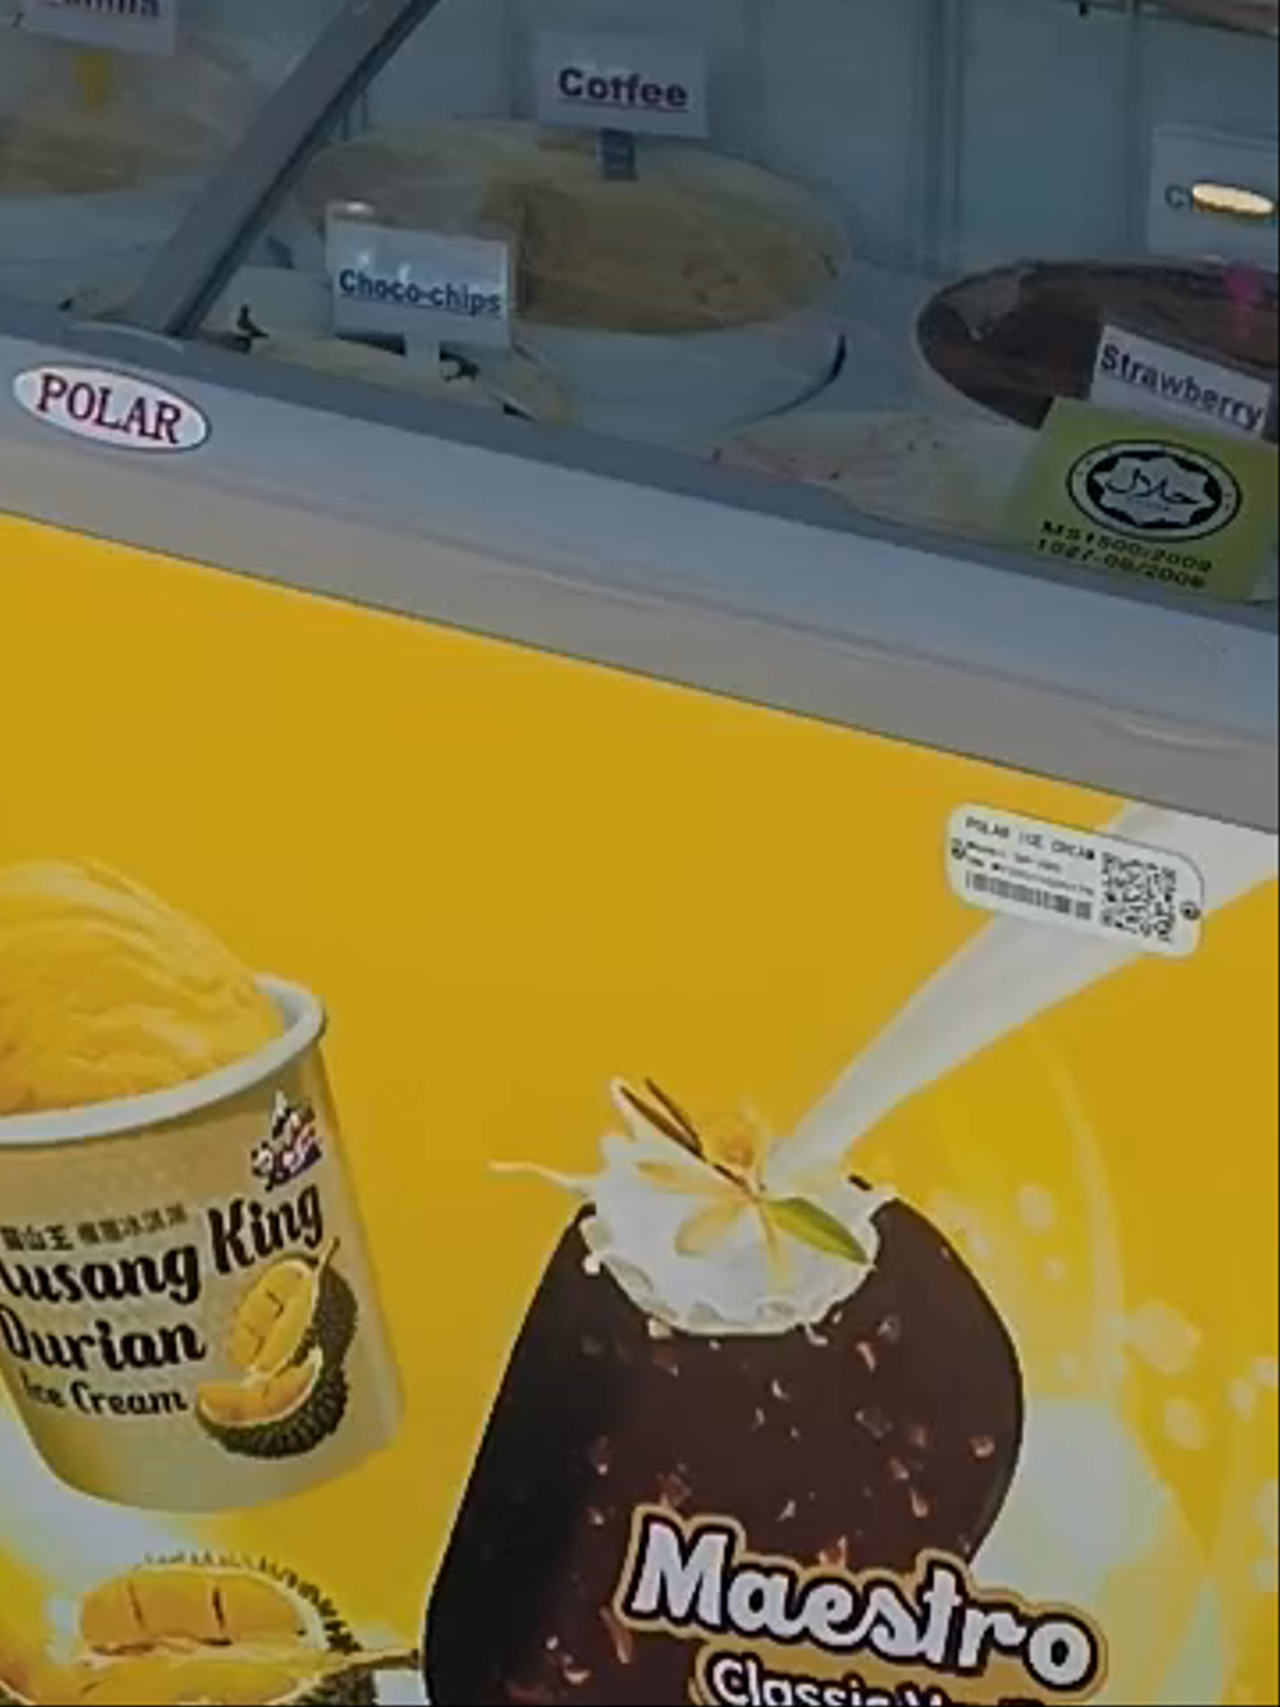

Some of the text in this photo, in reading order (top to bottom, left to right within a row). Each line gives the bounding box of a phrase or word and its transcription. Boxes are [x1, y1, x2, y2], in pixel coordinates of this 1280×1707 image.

[558, 67, 688, 108] Coffee
[339, 268, 501, 317] Choco-chips
[37, 373, 182, 444] POLAR
[1101, 344, 1263, 431] Strawberry
[206, 1183, 323, 1275] King
[20, 1374, 188, 1416] Ice Cream
[630, 1518, 1094, 1686] Maestro
